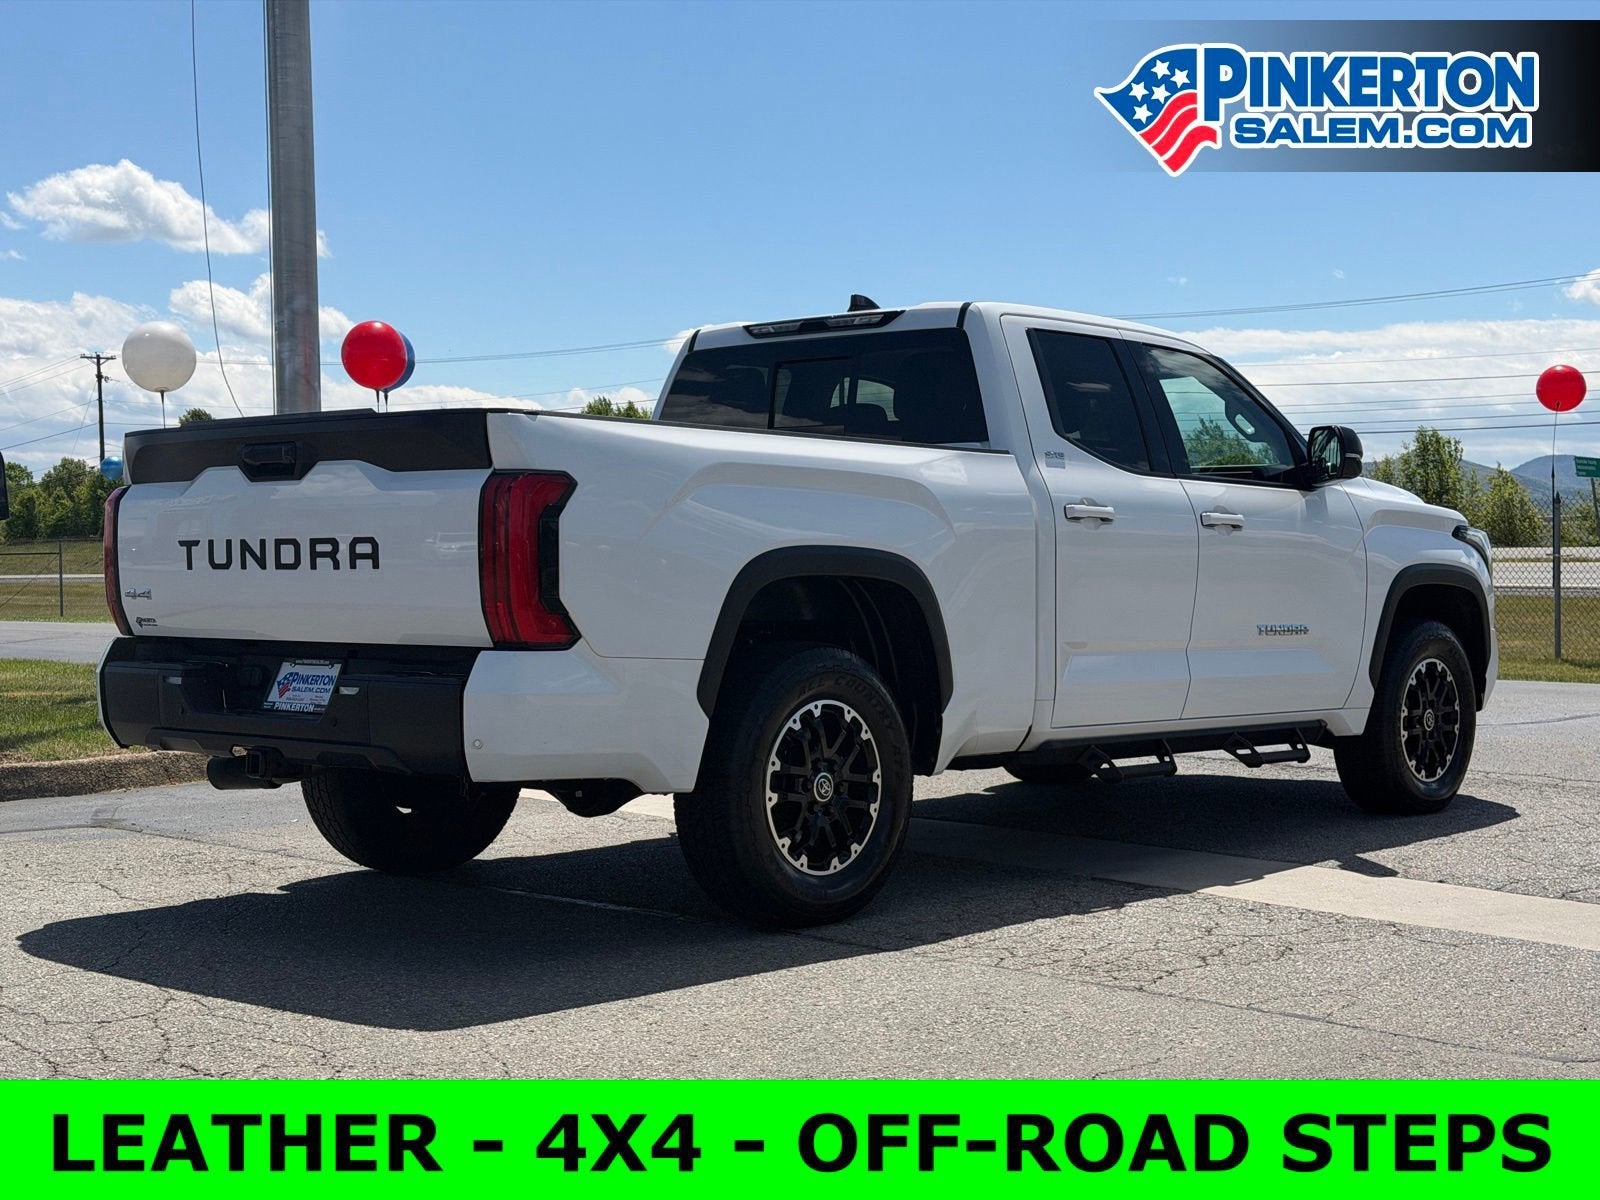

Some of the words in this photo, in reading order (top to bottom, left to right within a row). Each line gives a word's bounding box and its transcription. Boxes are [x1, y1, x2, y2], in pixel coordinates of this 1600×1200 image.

[177, 536, 380, 571] TUNDRA
[289, 672, 336, 687] PINKERTON
[273, 702, 316, 713] PINKERTON
